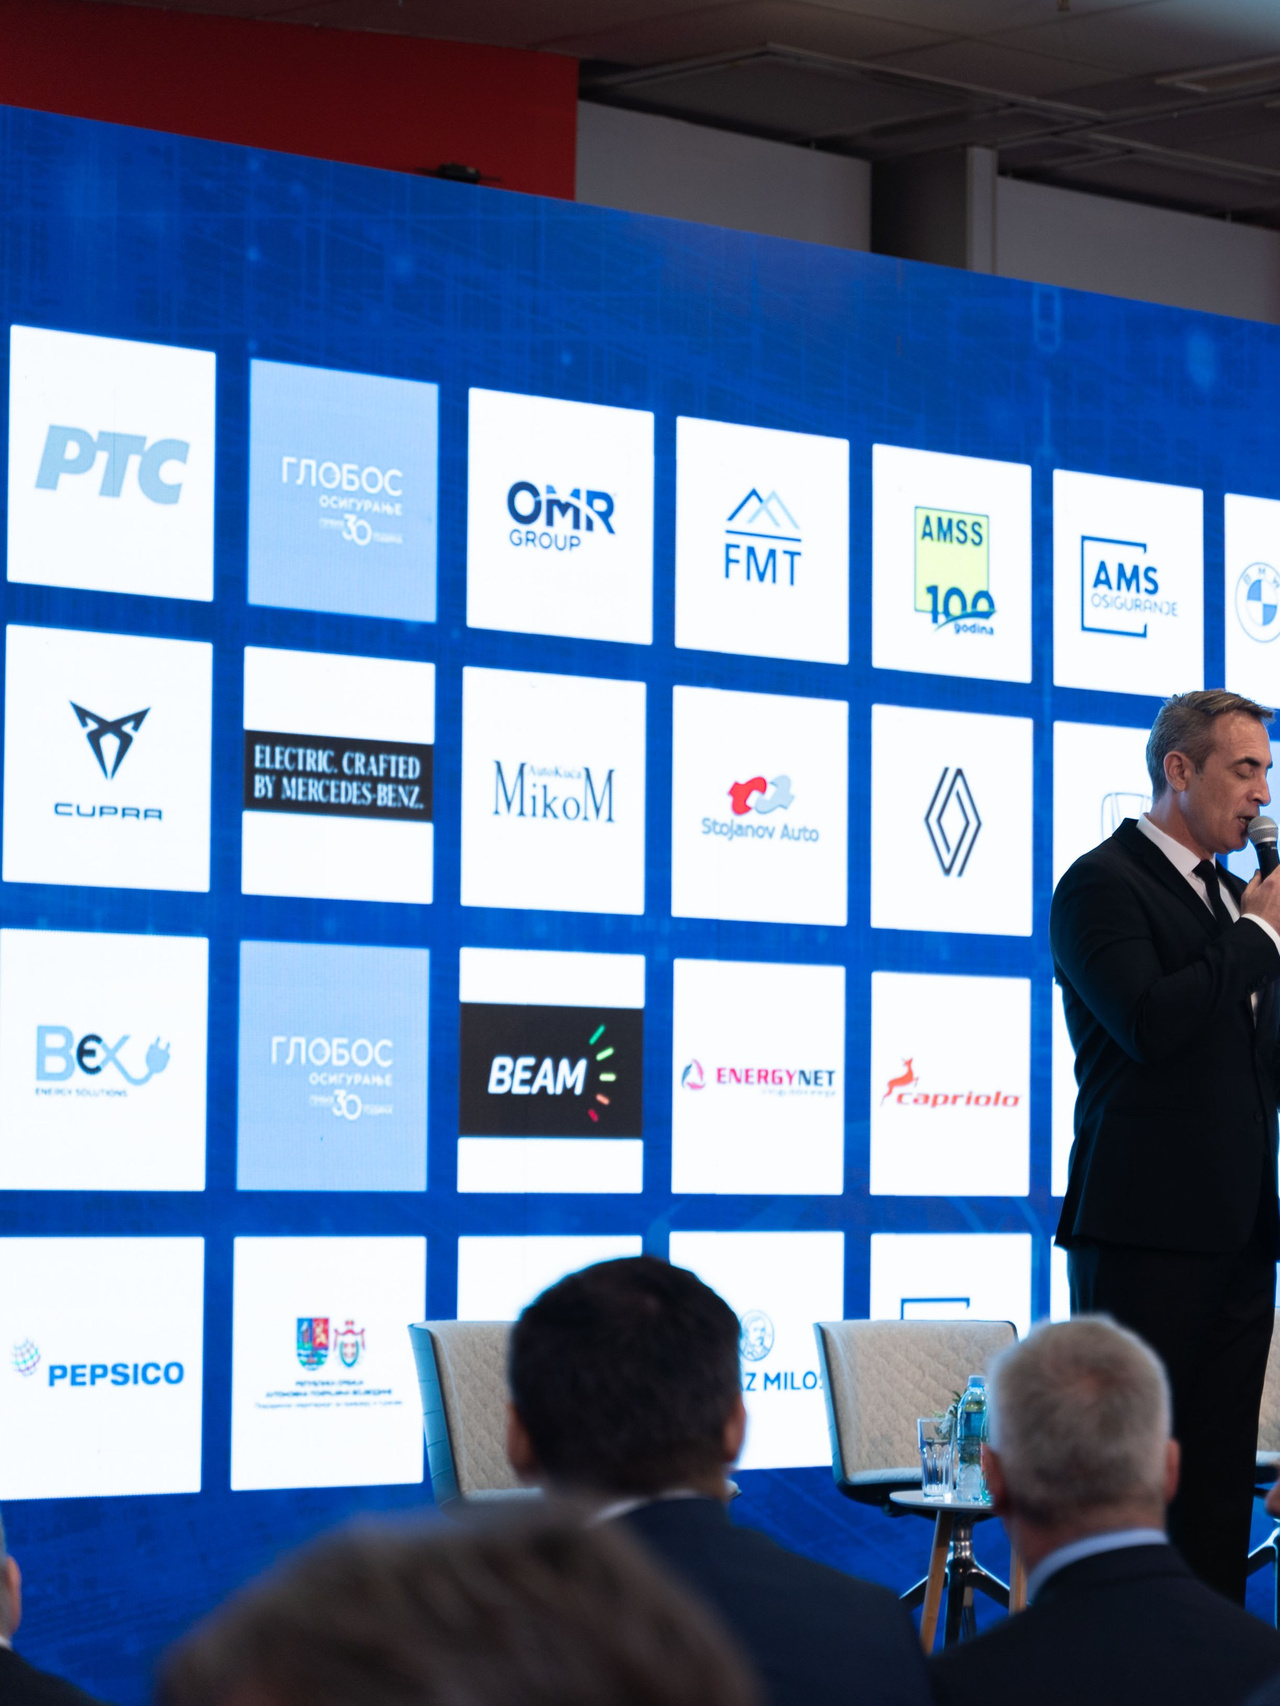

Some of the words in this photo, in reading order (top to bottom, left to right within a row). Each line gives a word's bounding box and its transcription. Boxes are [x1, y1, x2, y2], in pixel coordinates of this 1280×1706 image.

[282, 457, 403, 496] ГЛОБОС
[319, 495, 403, 516] ОСИГУРАЊЕ
[507, 481, 615, 534] OMR
[342, 513, 372, 546] 30
[509, 529, 581, 551] GROUP
[921, 515, 983, 546] AMSS
[725, 543, 802, 586] FMT
[1092, 560, 1160, 595] AMS
[926, 584, 997, 624] 100
[1091, 593, 1178, 617] OSIGURANJE
[954, 622, 994, 635] godina
[254, 744, 338, 774] ELECTRIC.
[342, 750, 421, 780] CRAFTED
[254, 774, 275, 799] BY
[281, 776, 424, 810] MERCEDES-BENZ.
[54, 803, 162, 821] CUPRA
[702, 818, 775, 842] Stojanov
[780, 823, 819, 842] Auto
[271, 1036, 393, 1067] ГЛОБОС
[309, 1072, 393, 1087] ОСИГУРАЊЕ
[487, 1055, 588, 1095] BEAM
[717, 1067, 835, 1087] ENERGYNET
[332, 1089, 362, 1120] 30
[896, 1091, 1021, 1108] capriolo
[48, 1361, 185, 1387] PEPSICO
[763, 1371, 823, 1391] MILO
